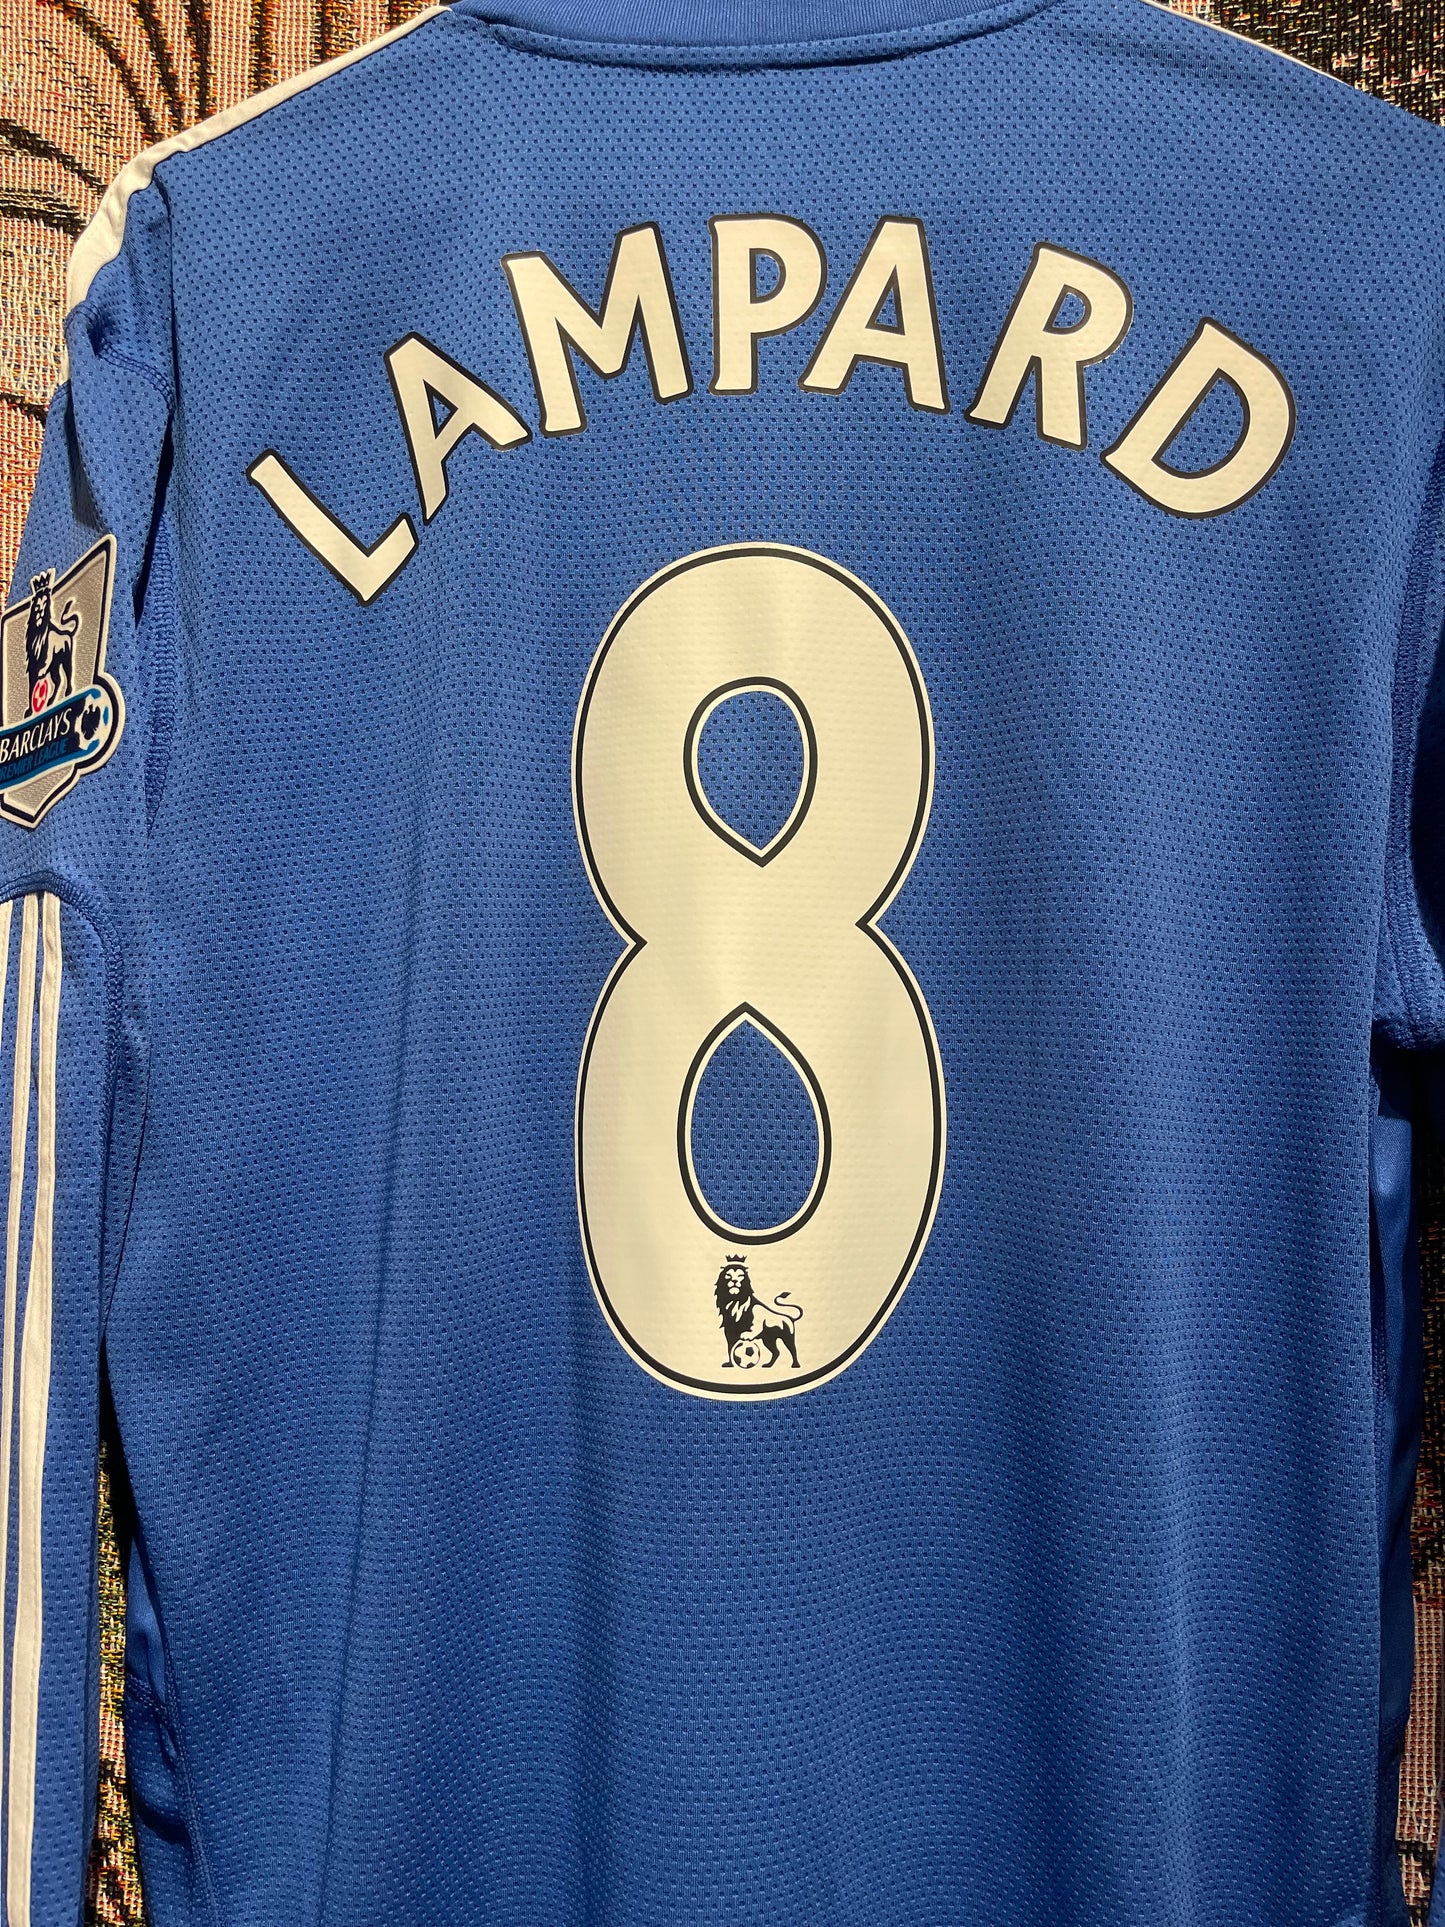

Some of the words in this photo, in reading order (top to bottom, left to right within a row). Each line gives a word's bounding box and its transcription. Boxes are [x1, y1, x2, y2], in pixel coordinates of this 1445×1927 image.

[248, 215, 1297, 604] LAMPARD
[0, 708, 72, 764] BARCLAYS
[0, 755, 34, 781] REMIER
[571, 541, 946, 1402] 8
